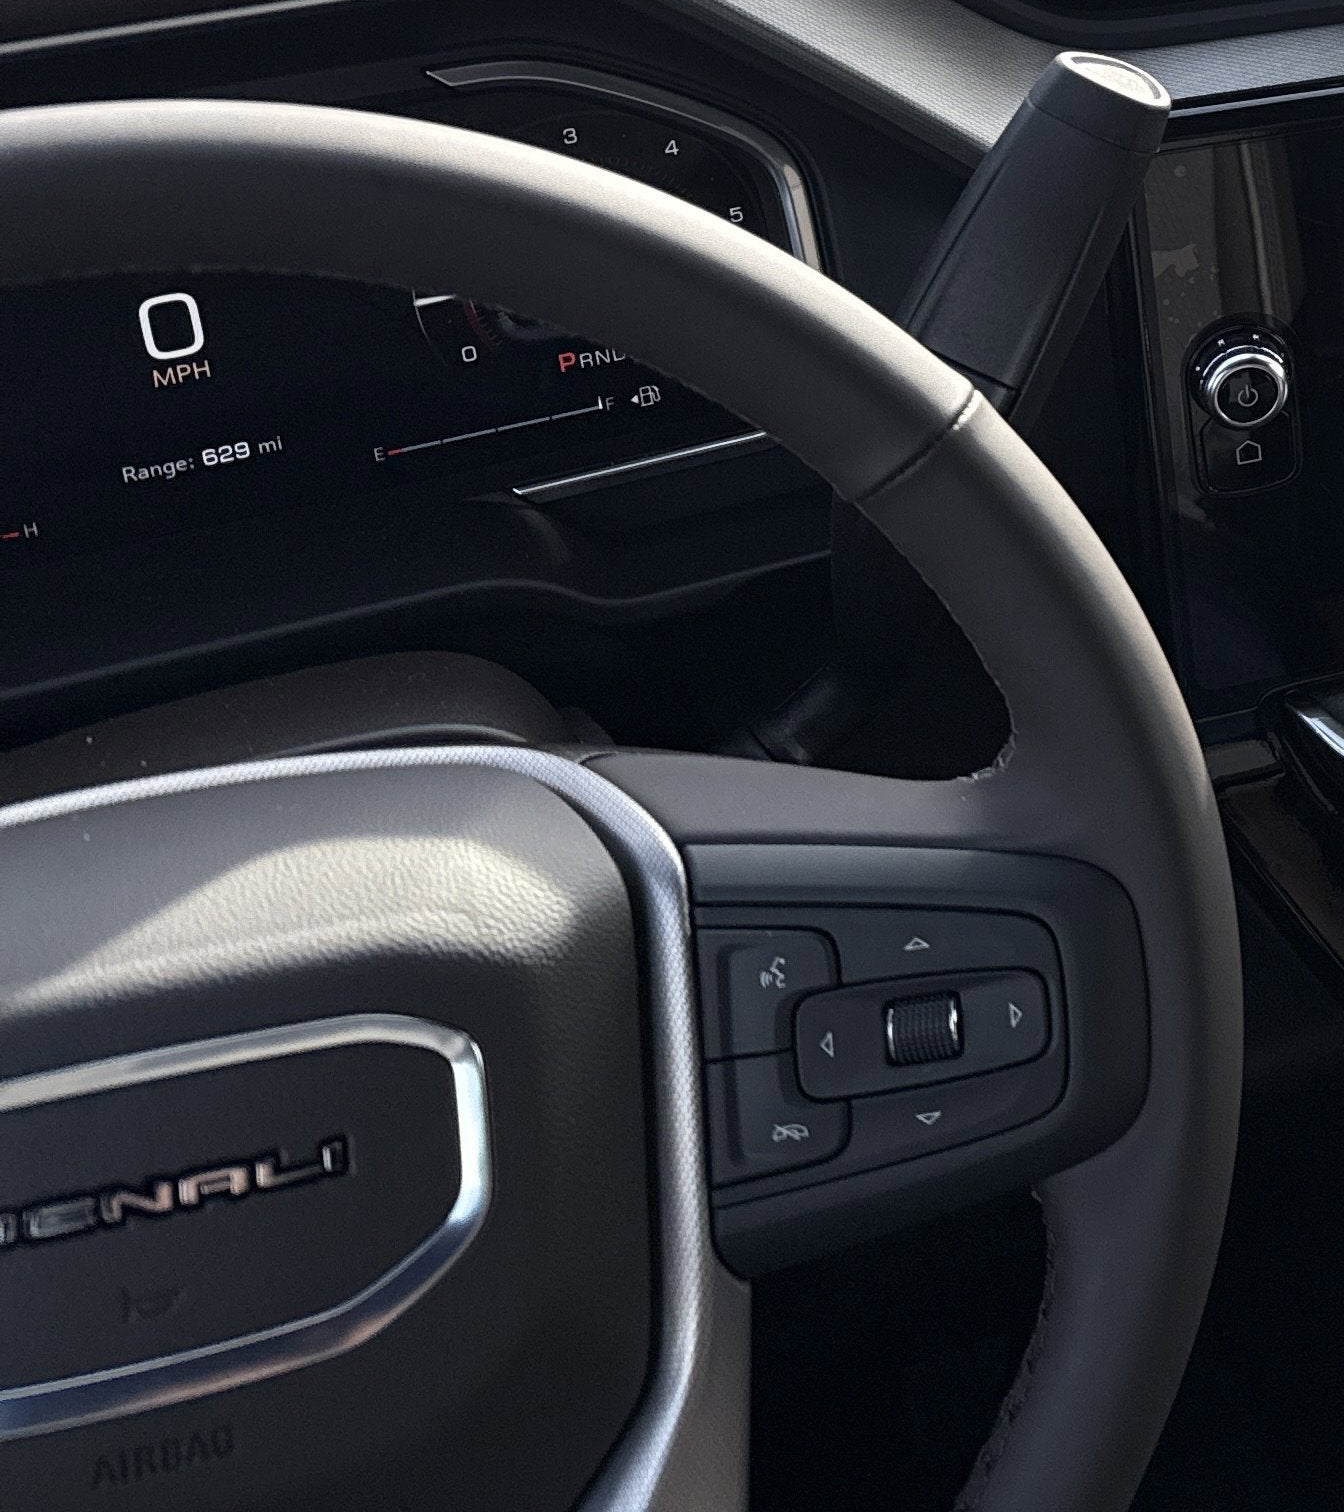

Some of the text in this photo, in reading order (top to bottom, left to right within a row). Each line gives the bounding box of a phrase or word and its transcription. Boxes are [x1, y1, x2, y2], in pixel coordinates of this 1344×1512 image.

[562, 127, 577, 145] 3
[664, 139, 679, 157] 4
[729, 206, 744, 224] 5
[138, 292, 206, 361] 0
[461, 345, 478, 364] 0
[152, 359, 212, 389] MPH
[605, 396, 616, 411] F
[122, 435, 284, 484] Range: 629 mi
[374, 446, 386, 462] E
[23, 523, 39, 540] H
[0, 1133, 352, 1246] ENALI
